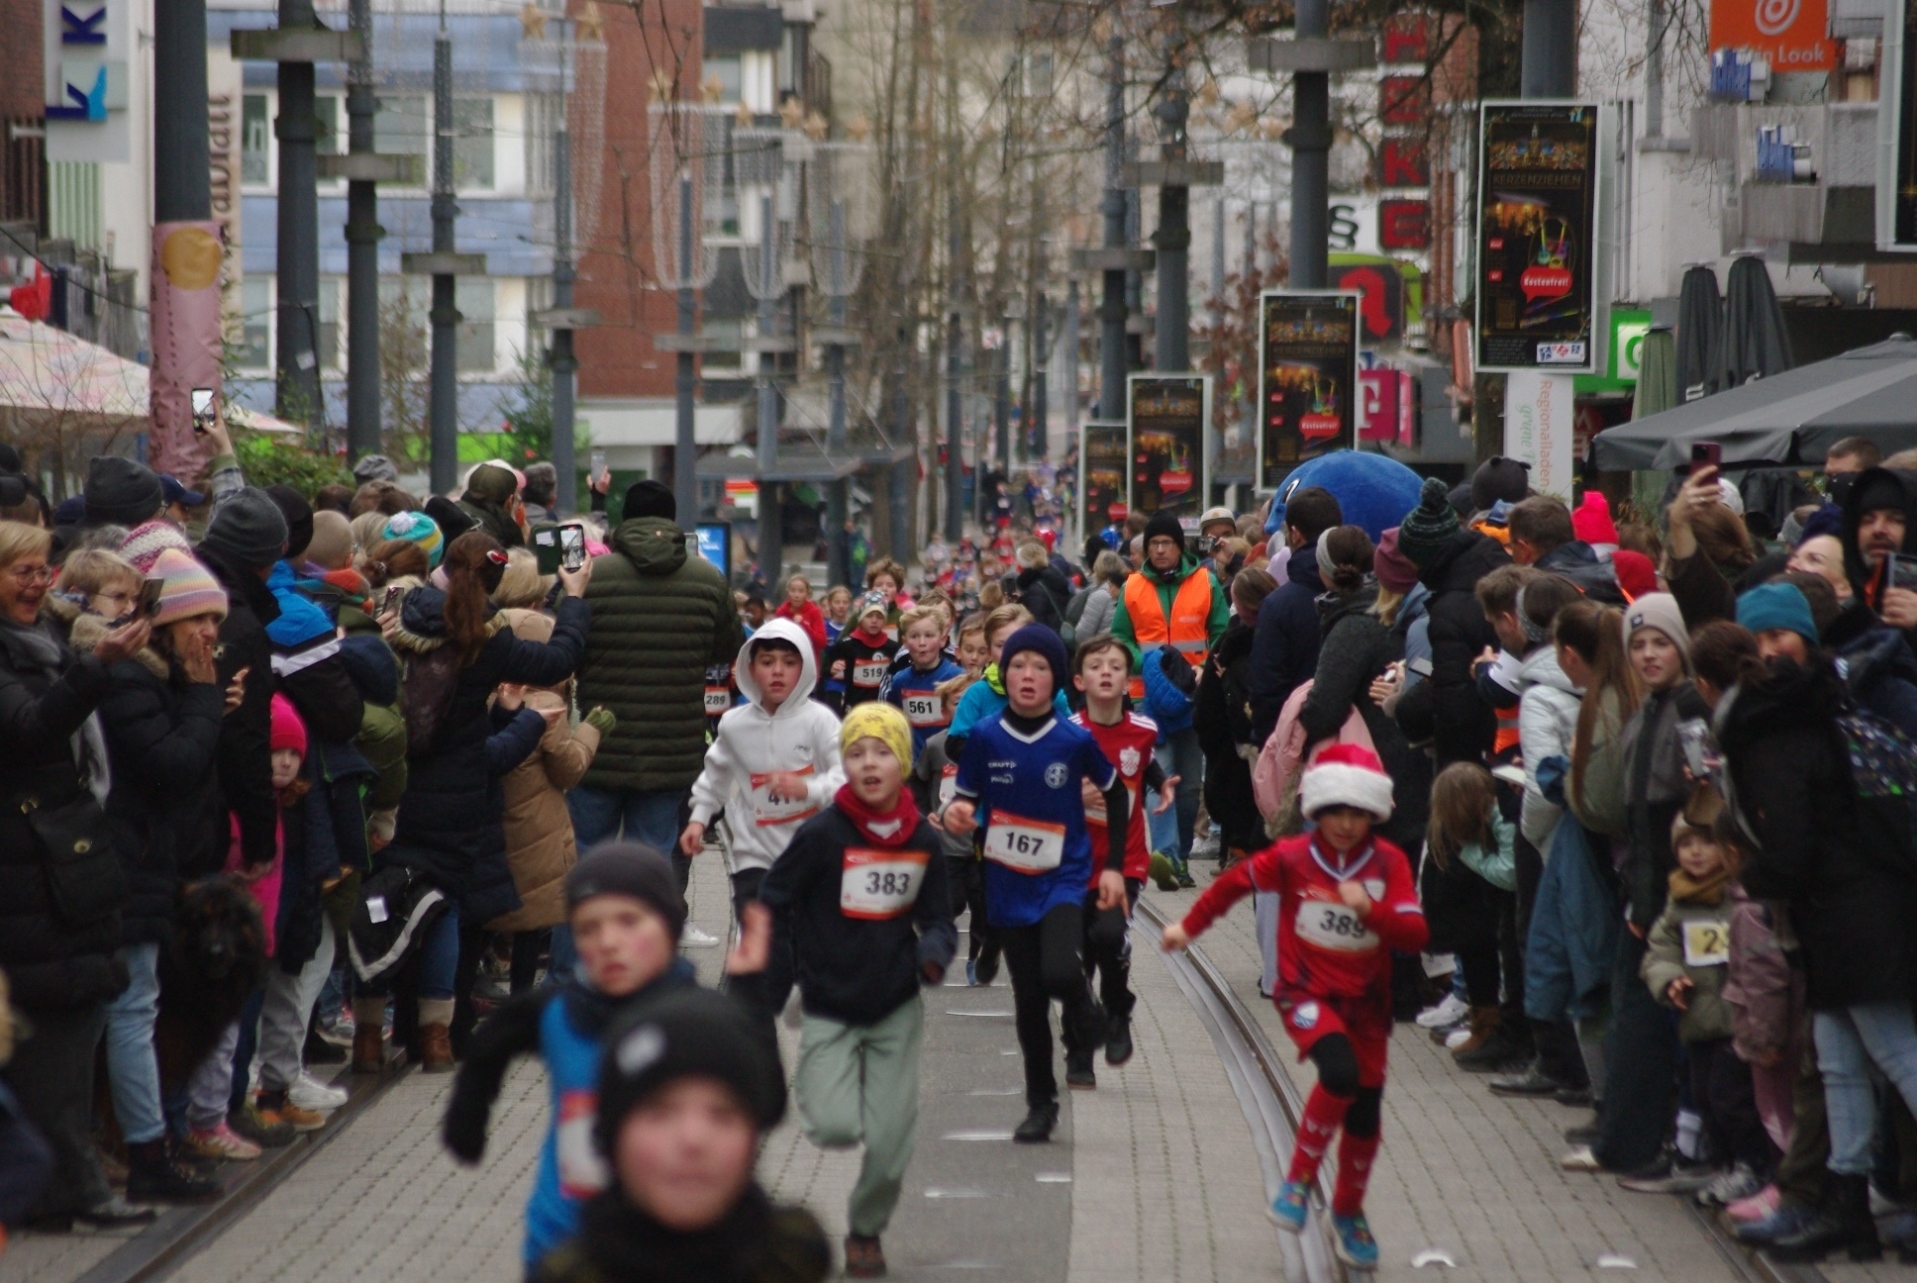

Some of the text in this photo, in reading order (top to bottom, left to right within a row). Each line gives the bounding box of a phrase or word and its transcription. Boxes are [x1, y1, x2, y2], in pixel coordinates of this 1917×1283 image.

[1778, 42, 1824, 64] Look
[1523, 274, 1569, 287] Kostenfrei!
[1536, 381, 1553, 488] Regionalladen
[862, 667, 883, 679] 519
[909, 701, 933, 714] 561
[1006, 831, 1044, 857] 167
[865, 871, 910, 896] 383
[1319, 910, 1366, 940] 389
